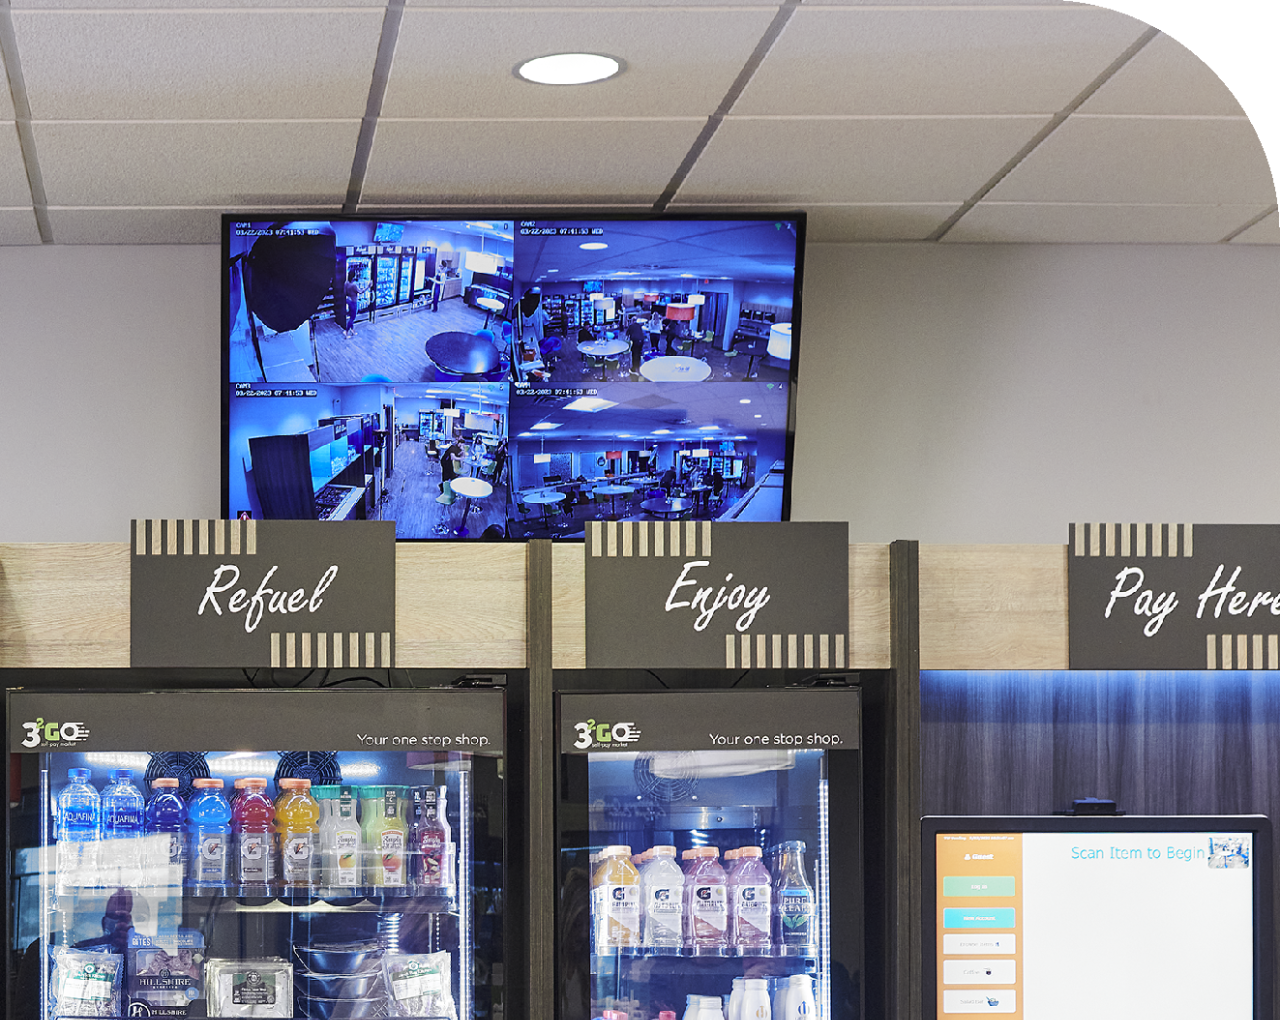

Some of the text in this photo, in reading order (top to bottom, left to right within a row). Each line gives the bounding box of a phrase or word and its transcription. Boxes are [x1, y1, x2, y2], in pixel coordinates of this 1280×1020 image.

[198, 564, 339, 633] Refuel
[665, 560, 771, 632] Enjoy
[1104, 566, 1179, 637] Pay
[357, 734, 491, 750] Your one stop shop.
[709, 733, 843, 748] Your one stop shop.
[1071, 846, 1205, 863] Scan Item to Begin
